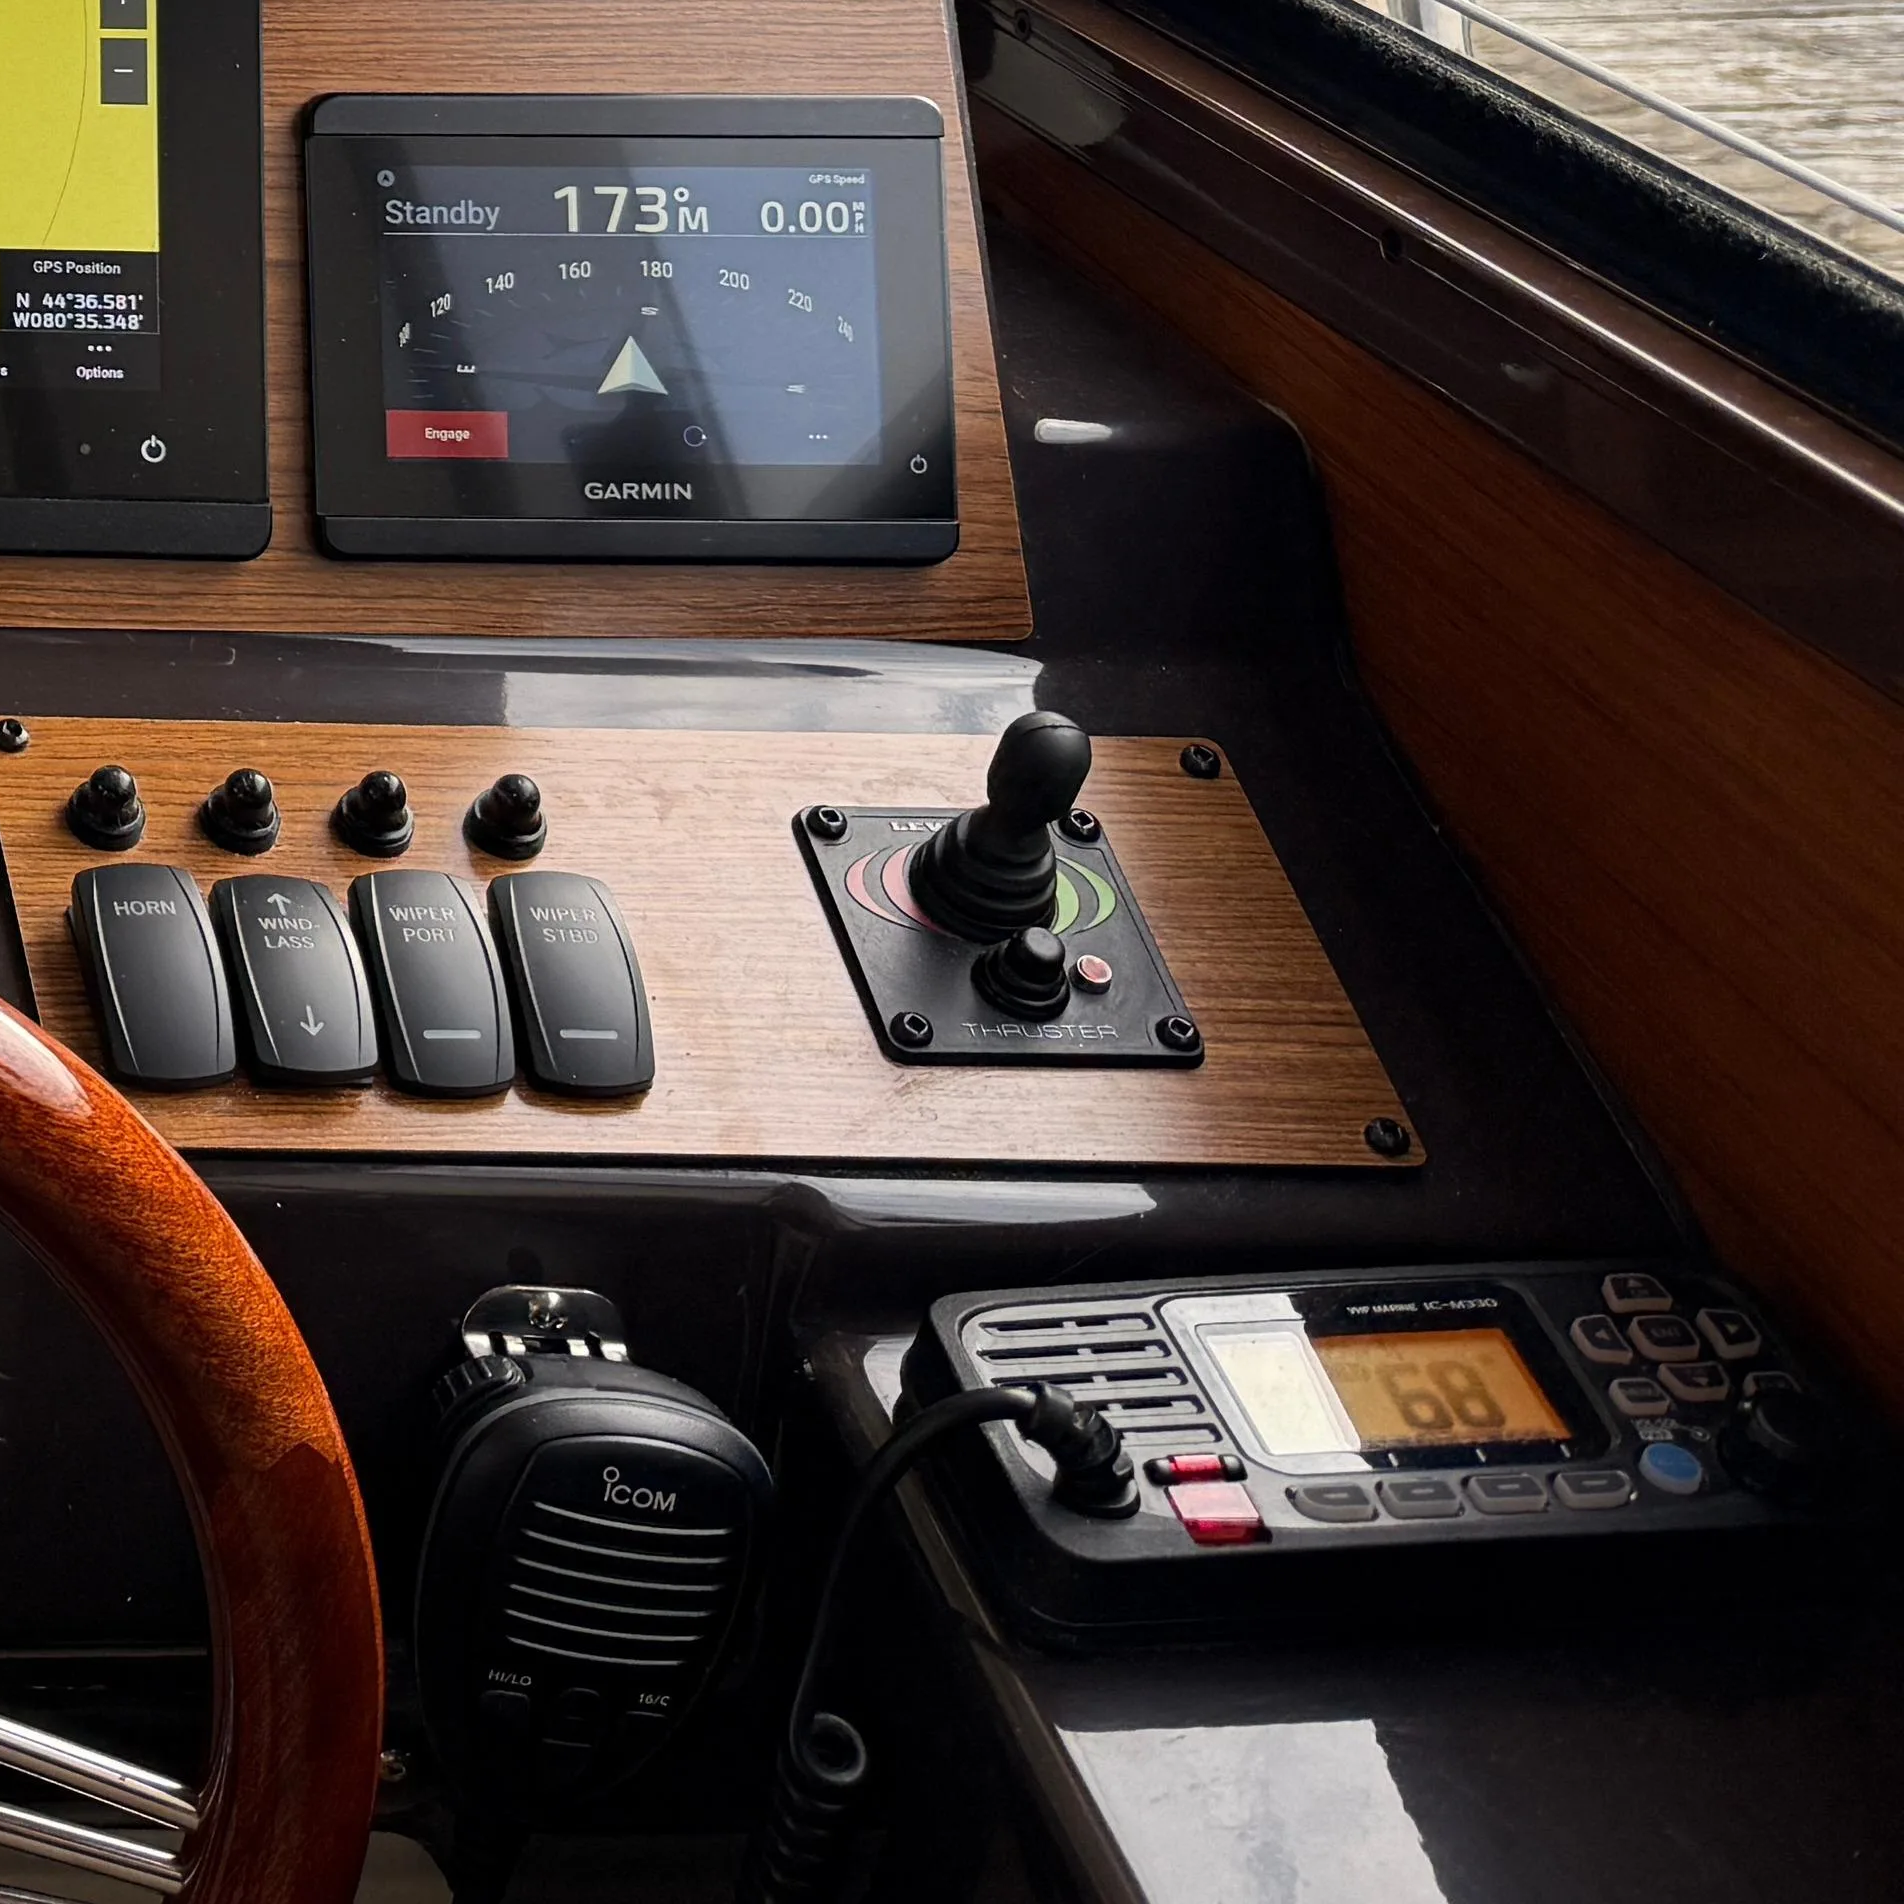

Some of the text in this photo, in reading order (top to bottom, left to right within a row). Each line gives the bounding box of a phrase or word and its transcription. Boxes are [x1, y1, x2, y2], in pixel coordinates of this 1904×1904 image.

[808, 174, 865, 186] GPS Speed
[384, 199, 500, 231] Standby
[760, 201, 850, 233] 0.00
[33, 260, 121, 275] GPS Position
[558, 260, 673, 281] 160 180
[485, 271, 515, 294] 140
[719, 269, 750, 290] 200
[16, 292, 30, 308] N
[430, 293, 451, 317] 120
[787, 288, 813, 313] 220
[76, 365, 124, 380] Options
[424, 426, 470, 442] Engage
[584, 481, 693, 501] GARMIN
[113, 900, 177, 917] HORN
[389, 905, 456, 923] WIPER
[529, 906, 597, 924] WIPER
[257, 916, 321, 931] WIND-
[264, 934, 315, 949] LASS
[403, 925, 456, 943] PORT
[542, 926, 599, 945] STBD
[961, 1022, 1120, 1040] THRUSTER
[1375, 1360, 1506, 1430] 68
[488, 1668, 533, 1687] HI/LO
